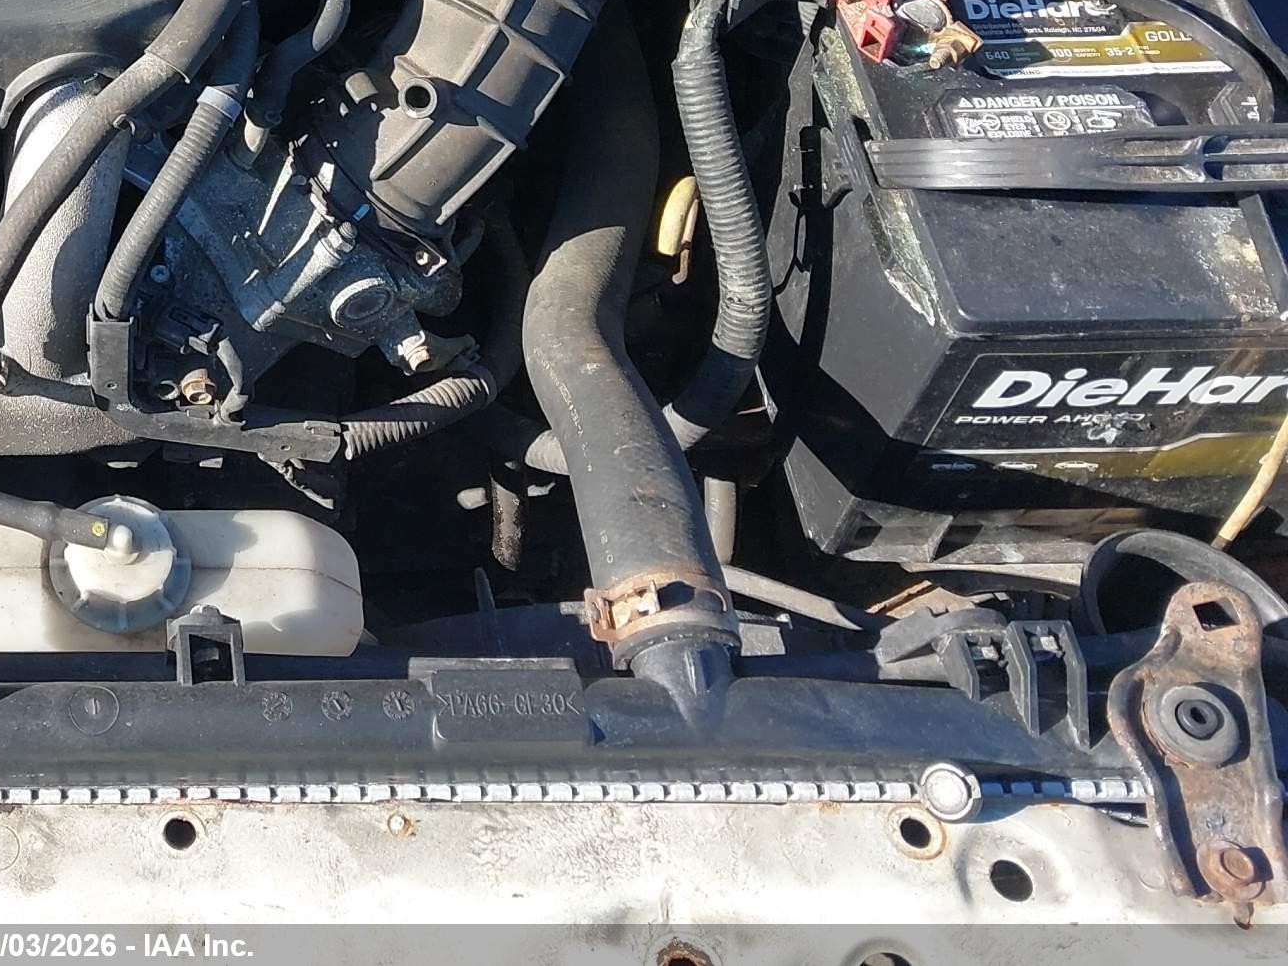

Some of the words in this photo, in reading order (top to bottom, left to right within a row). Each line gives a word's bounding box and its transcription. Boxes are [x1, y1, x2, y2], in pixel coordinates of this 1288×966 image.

[984, 50, 1010, 60] 540
[970, 96, 1043, 109] DANGER
[1059, 93, 1121, 107] POISON
[972, 365, 1288, 408] DieHar
[955, 414, 1048, 425] POWER
